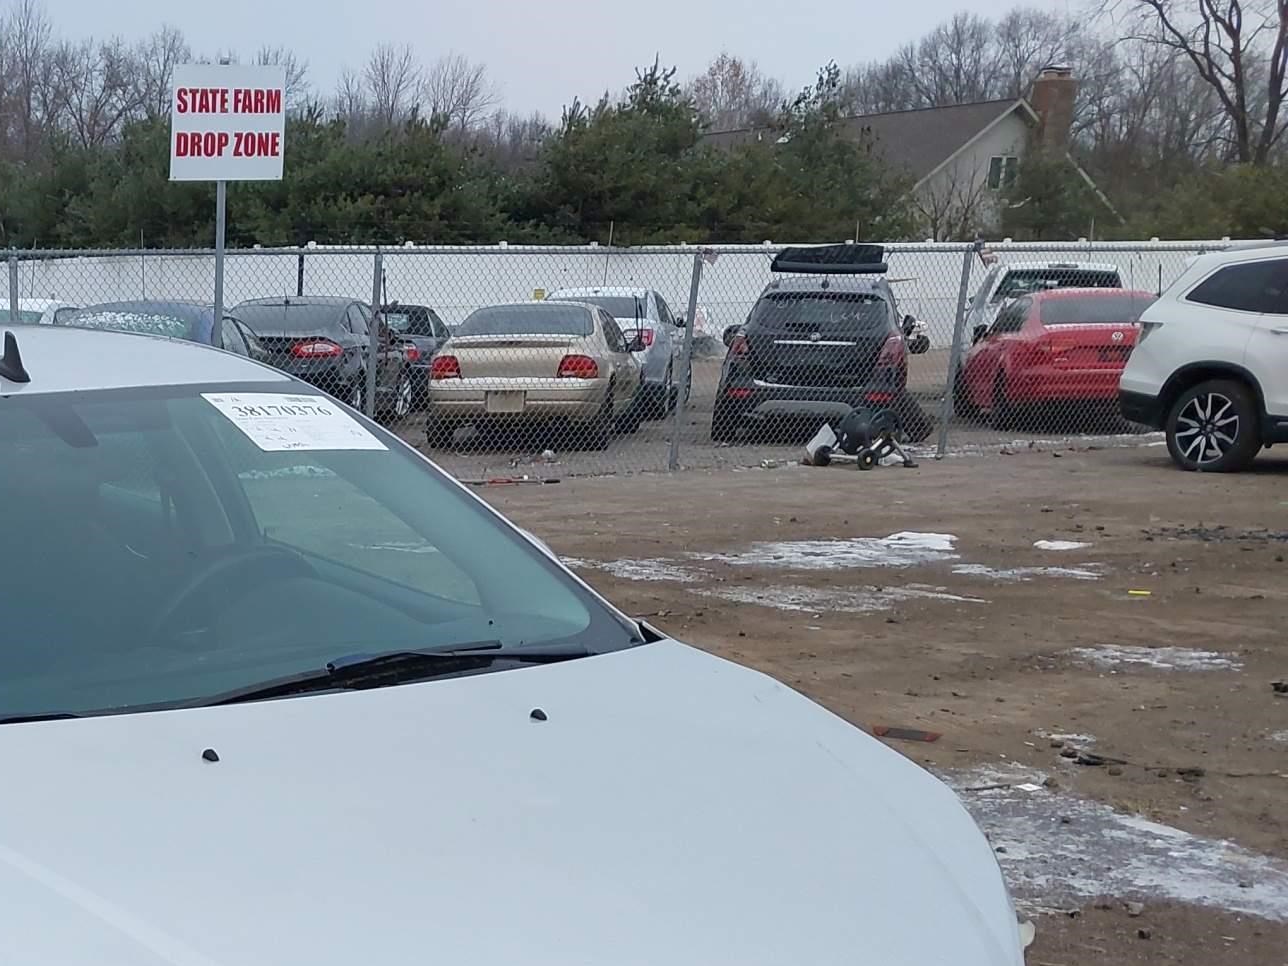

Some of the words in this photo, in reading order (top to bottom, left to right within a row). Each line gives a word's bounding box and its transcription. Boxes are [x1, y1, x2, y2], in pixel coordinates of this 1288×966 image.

[176, 87, 229, 113] STATE
[233, 88, 281, 114] FARM
[175, 132, 229, 157] DROP
[232, 132, 280, 157] ZONE
[232, 405, 333, 417] 38170376
